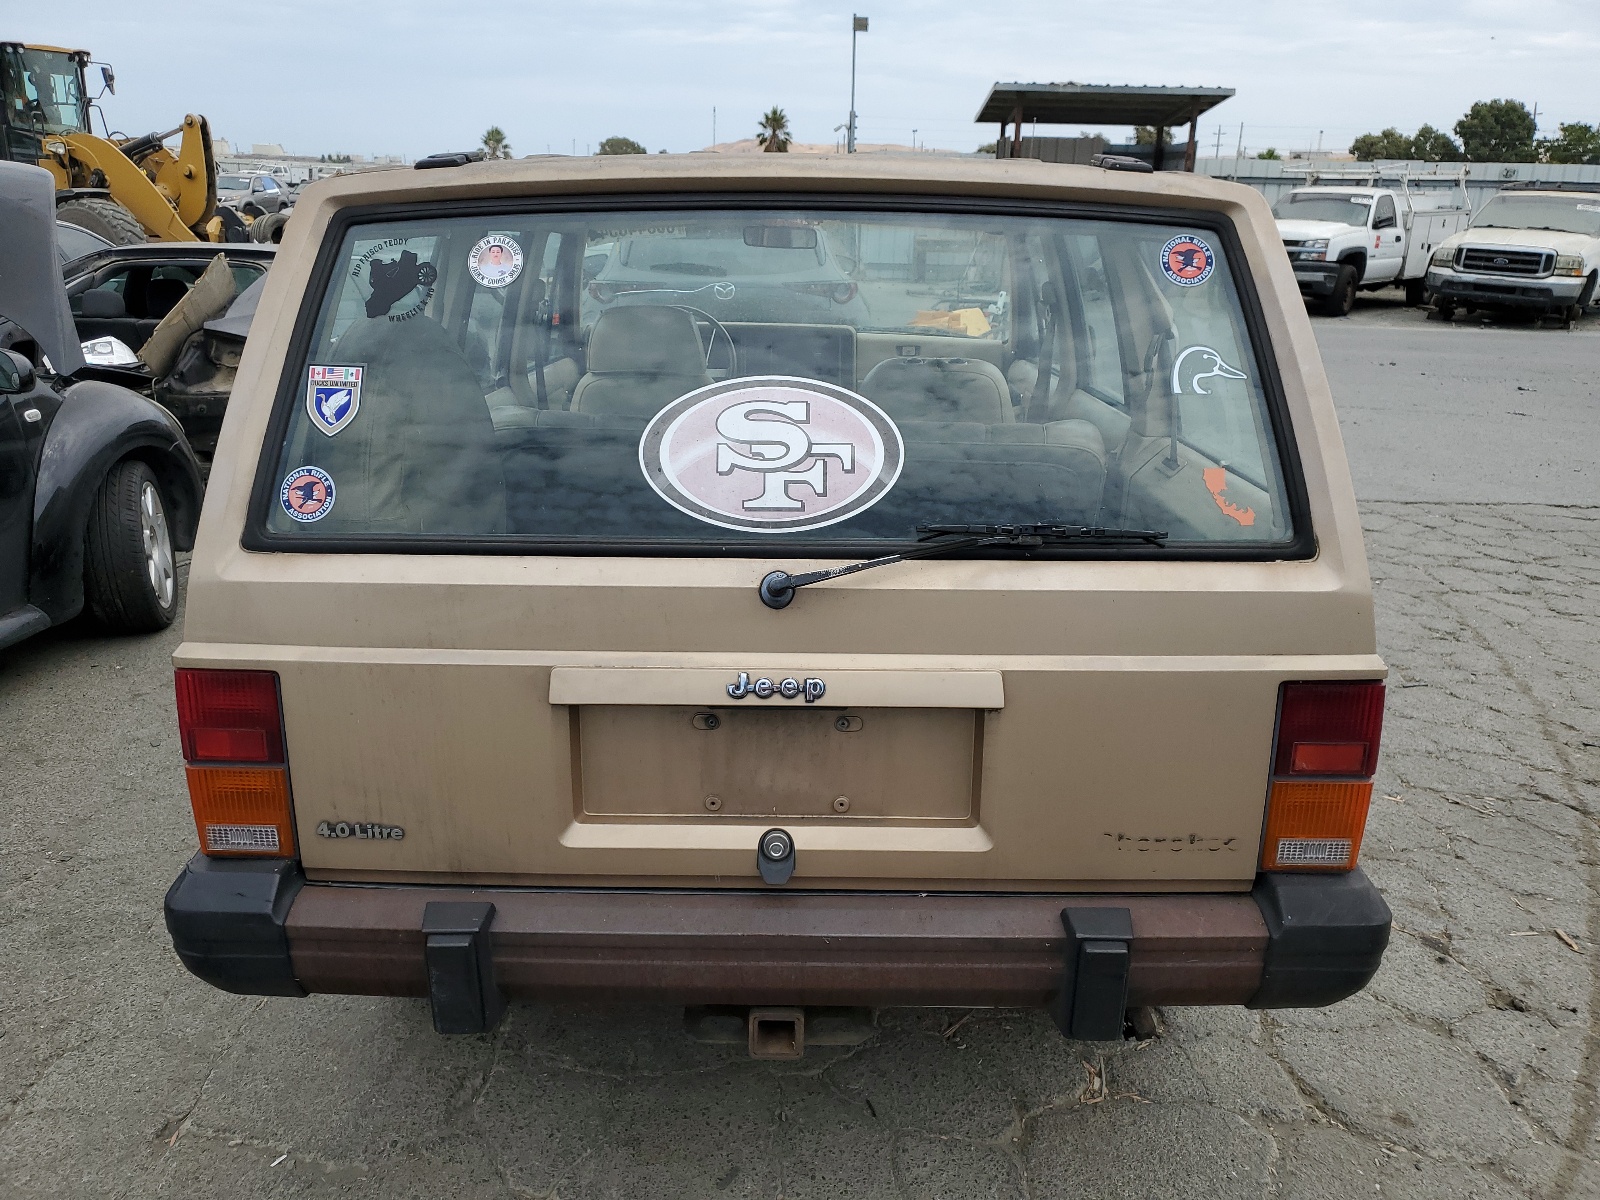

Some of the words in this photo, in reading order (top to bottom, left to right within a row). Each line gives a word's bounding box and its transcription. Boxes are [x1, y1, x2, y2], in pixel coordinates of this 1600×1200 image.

[351, 263, 362, 277] RIP
[359, 243, 383, 265] FRISCO
[383, 238, 409, 248] TEDDY
[471, 243, 483, 259] RIDE
[483, 238, 491, 246] IN
[493, 237, 520, 256] PARADISE
[1162, 236, 1191, 263] NATIONAL
[1192, 238, 1212, 257] RIFLE
[470, 265, 486, 282] JADEN
[1167, 265, 1212, 285] ASSOCIATION
[388, 304, 423, 323] WHEELIE
[310, 379, 329, 387] DUCKS
[329, 380, 358, 388] UNLIMITED
[282, 469, 310, 501] NATIONAL
[310, 469, 331, 487] RIFLE
[287, 496, 332, 520] ASSOCIATION
[727, 671, 826, 703] Jeep
[316, 821, 350, 839] 4.0
[354, 823, 405, 841] Litre
